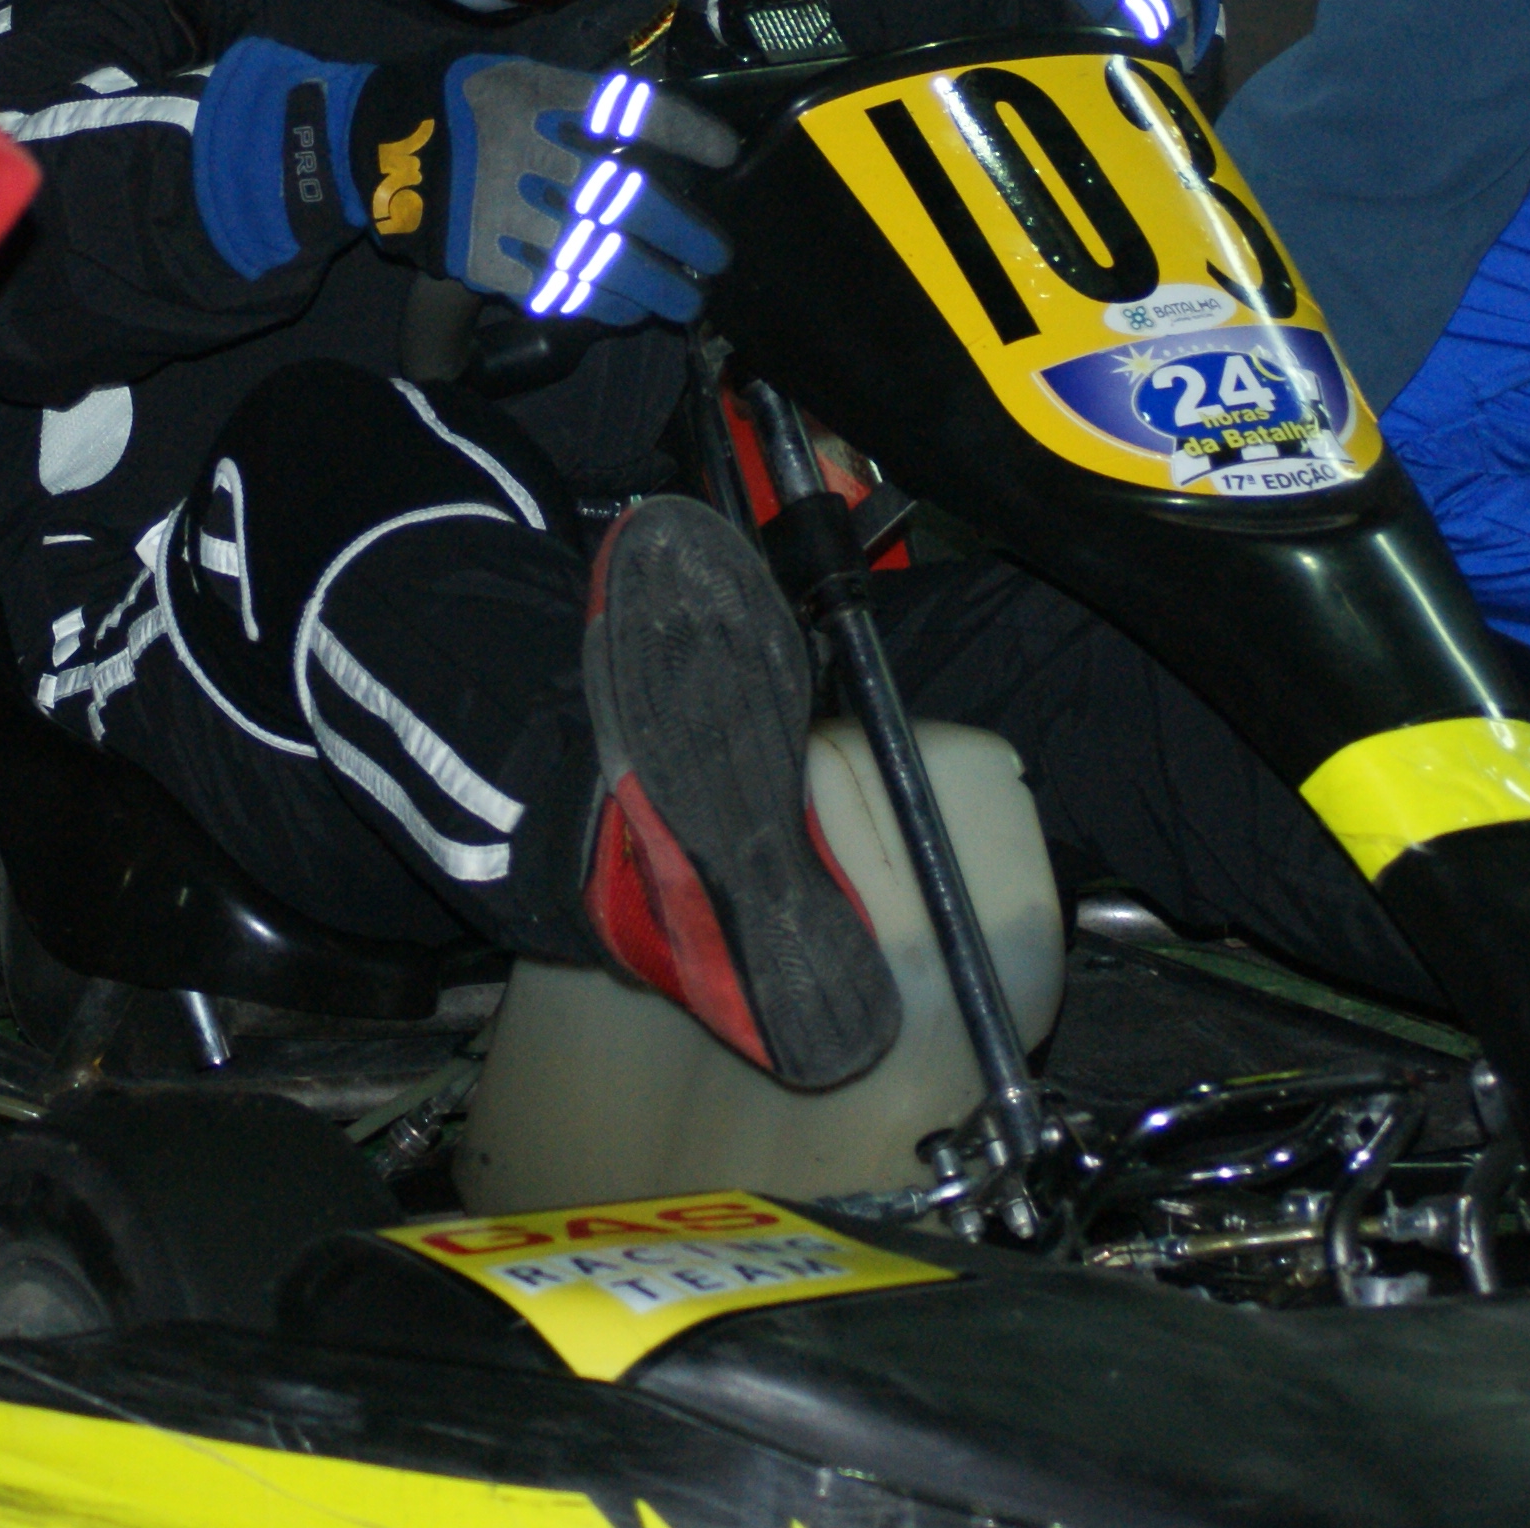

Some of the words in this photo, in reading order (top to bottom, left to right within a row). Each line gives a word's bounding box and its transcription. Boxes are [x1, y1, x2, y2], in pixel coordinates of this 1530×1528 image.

[293, 125, 323, 204] PRO
[864, 55, 1296, 346] 103
[1153, 298, 1221, 318] BATALHA
[1152, 355, 1276, 427] 24
[1183, 437, 1220, 457] da
[1222, 422, 1322, 449] Batalha
[1199, 407, 1269, 429] horas
[1262, 463, 1337, 489] EDIÇÃO
[422, 1204, 778, 1255] GAS
[502, 1234, 844, 1287] RACING
[611, 1258, 847, 1301] TEAM
